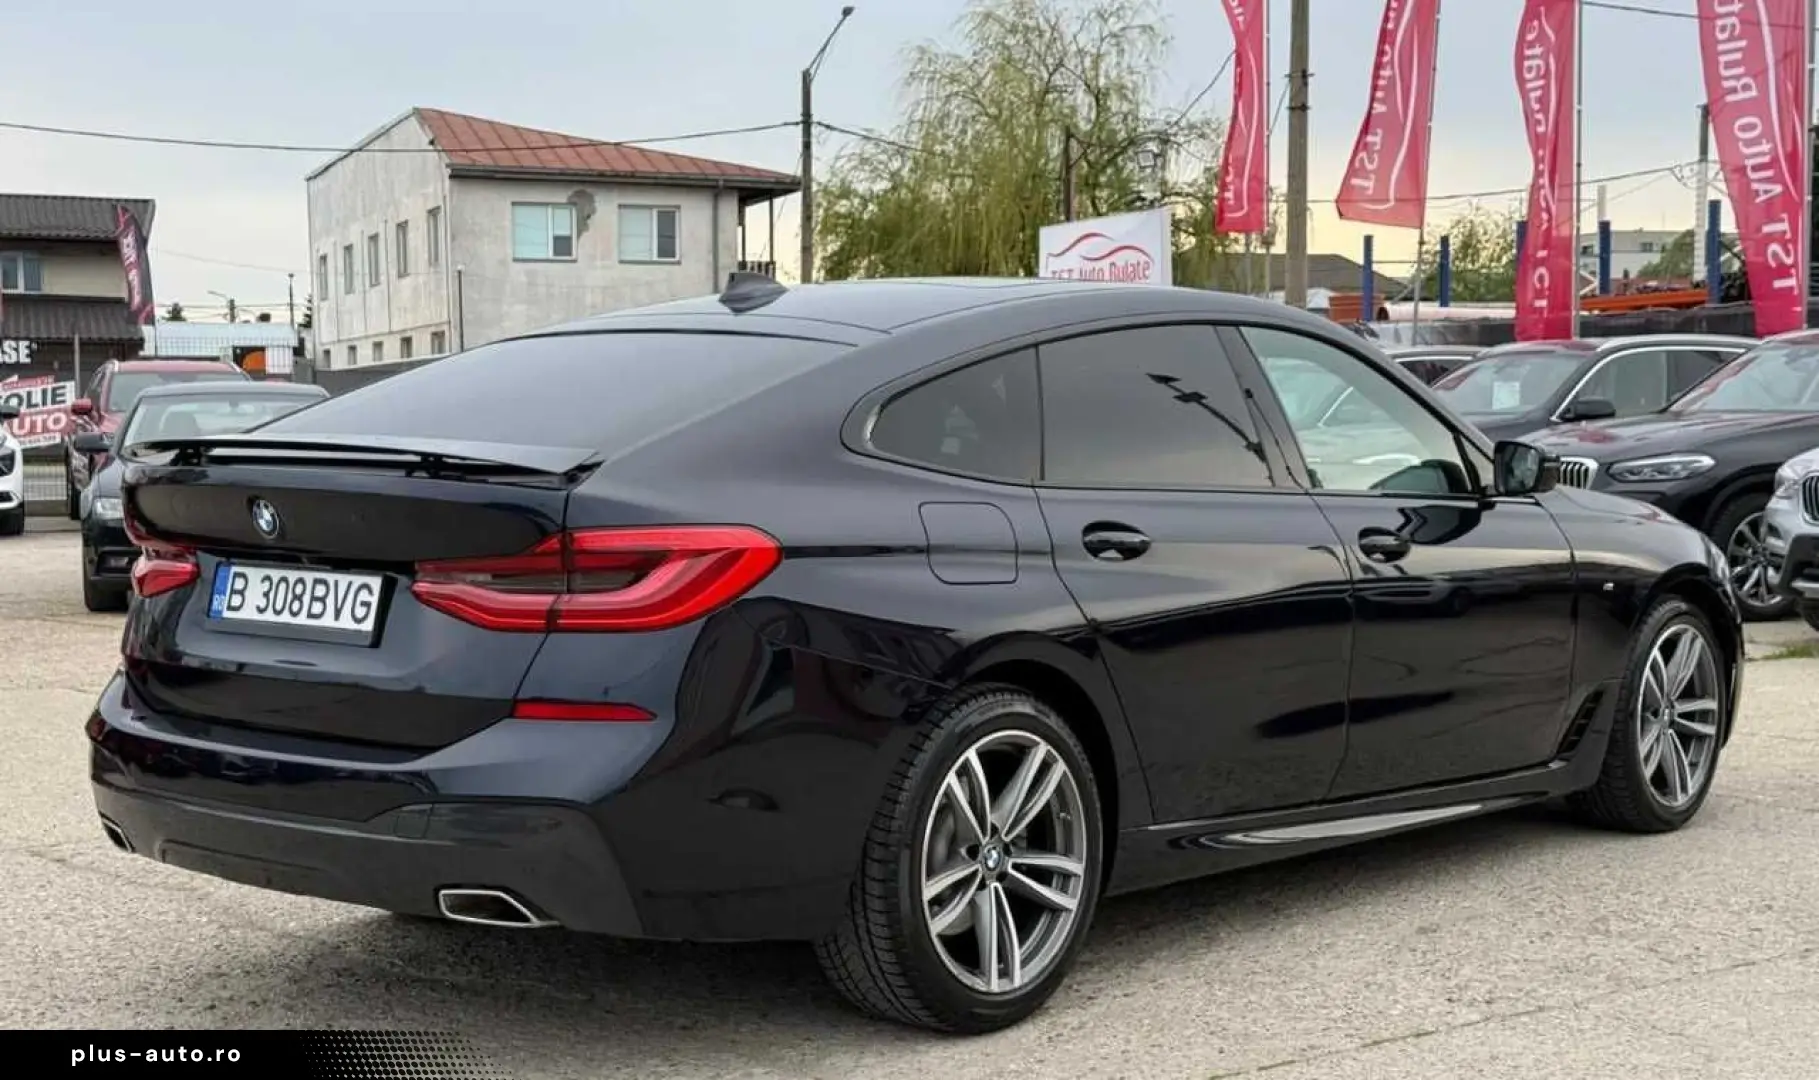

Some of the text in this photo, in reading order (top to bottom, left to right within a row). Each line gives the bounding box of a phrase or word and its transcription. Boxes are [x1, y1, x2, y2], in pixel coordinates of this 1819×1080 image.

[0, 384, 67, 410] OLIE
[5, 411, 68, 436] UTO
[226, 571, 249, 612] B
